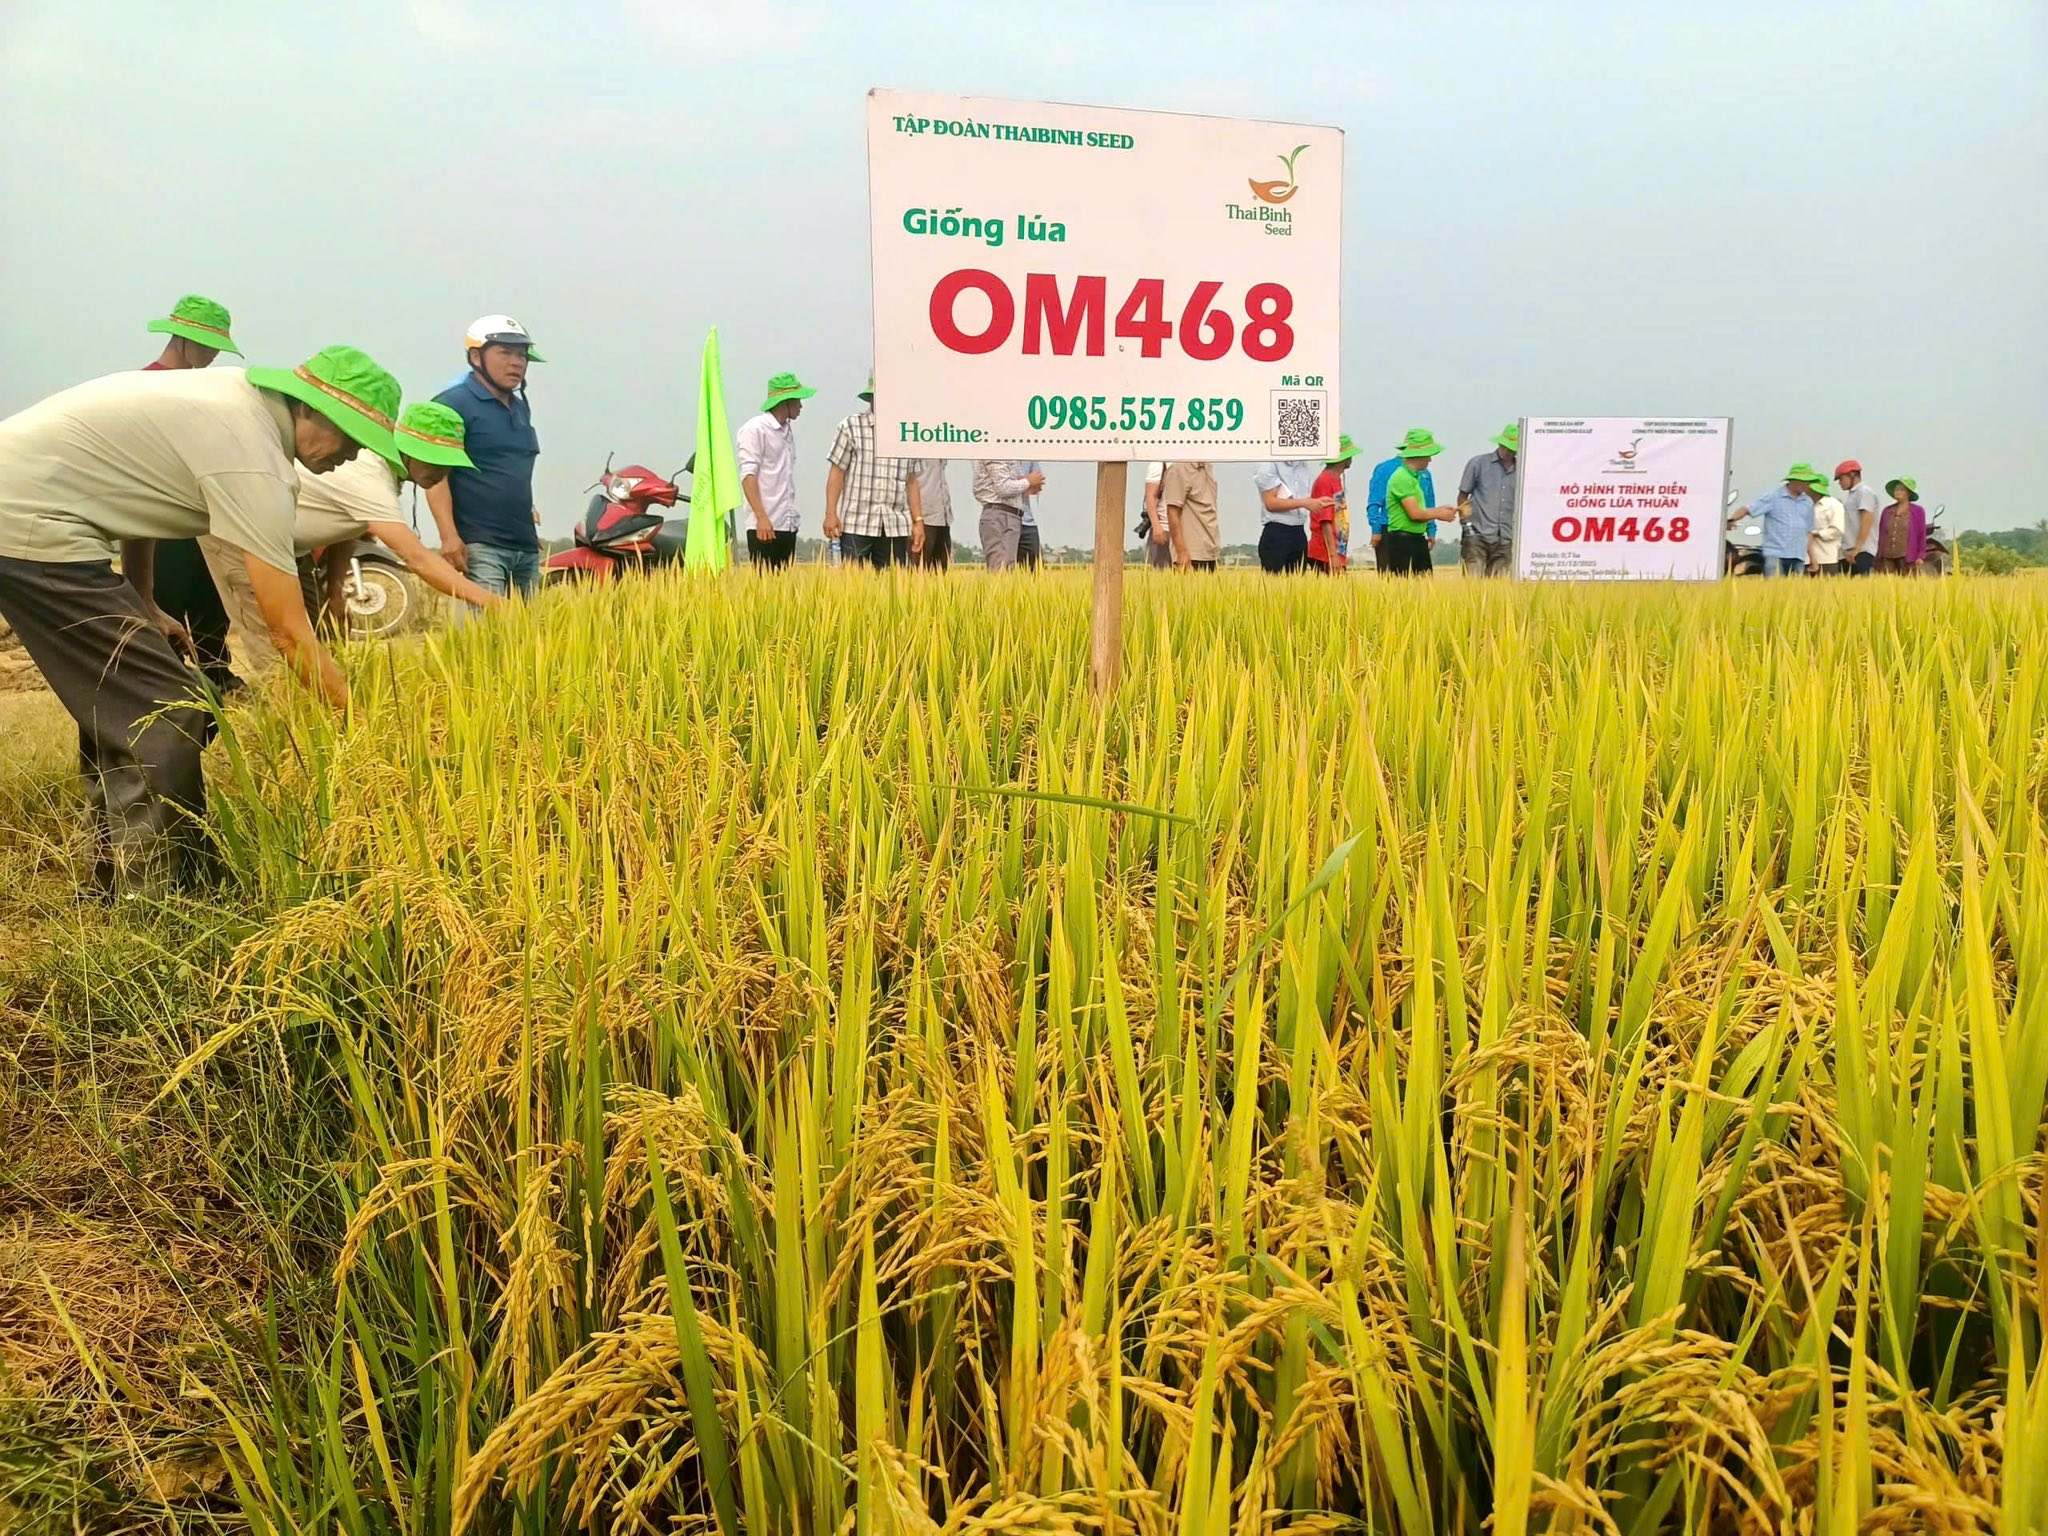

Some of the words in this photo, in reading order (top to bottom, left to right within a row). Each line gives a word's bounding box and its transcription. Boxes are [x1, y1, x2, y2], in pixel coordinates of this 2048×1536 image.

[893, 114, 930, 137] TẬP
[933, 118, 990, 139] ĐOÀN
[993, 124, 1083, 146] THAIBINH
[1087, 132, 1134, 150] SEED
[903, 207, 1004, 246] Giống
[1017, 214, 1066, 242] lúa
[1264, 223, 1292, 236] Seed
[929, 268, 1295, 362] OM468
[1281, 375, 1300, 386] Mã
[1305, 376, 1324, 387] QR
[899, 421, 989, 443] Hotline:
[1028, 395, 1244, 431] 0985.557.859
[1551, 516, 1690, 542] OM468
